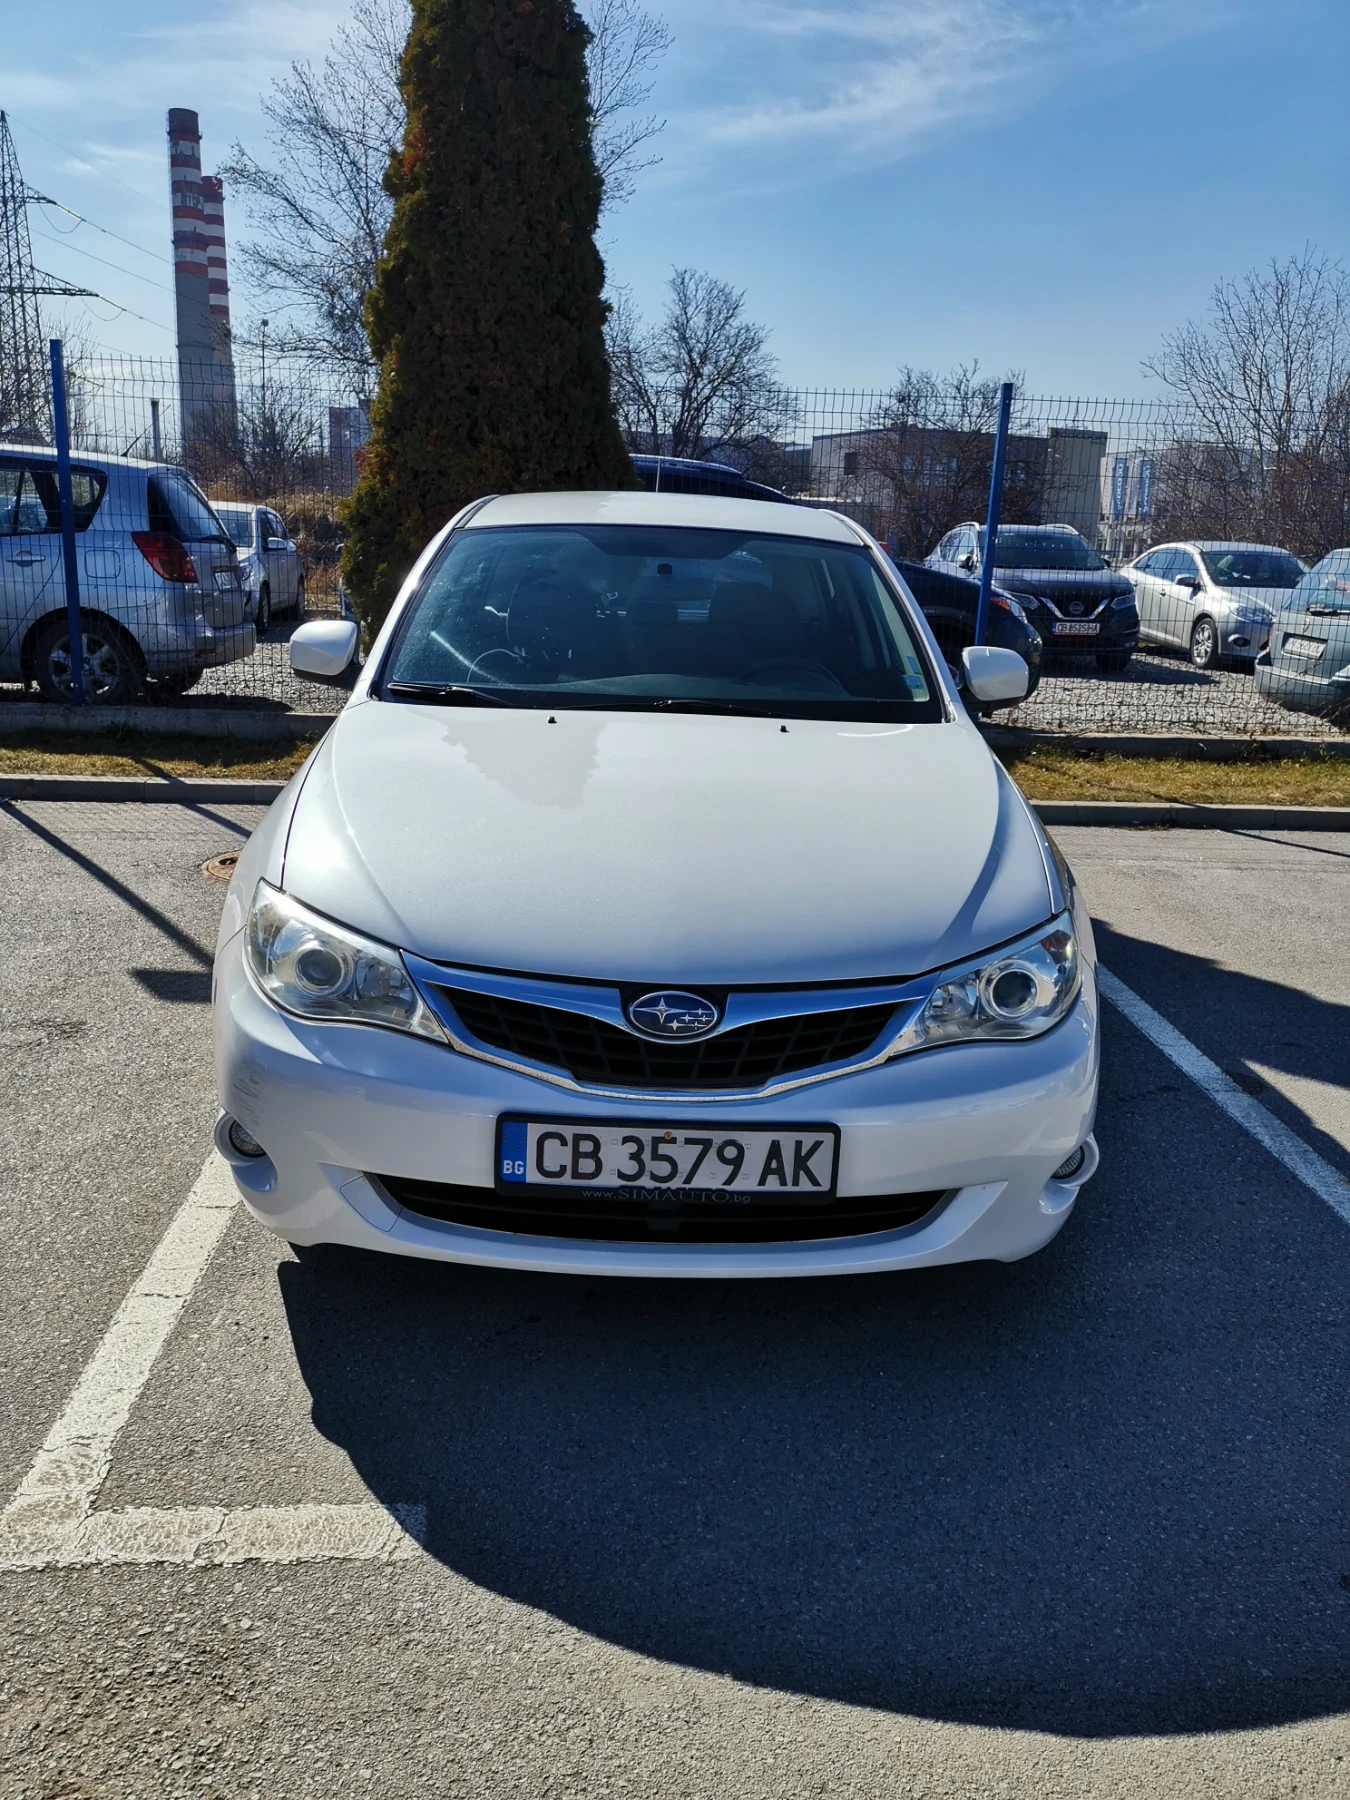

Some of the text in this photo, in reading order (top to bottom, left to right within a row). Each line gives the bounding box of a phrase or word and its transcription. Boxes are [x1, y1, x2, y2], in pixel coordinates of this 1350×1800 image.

[503, 1160, 524, 1174] BG
[536, 1131, 825, 1187] CB 3579 AK
